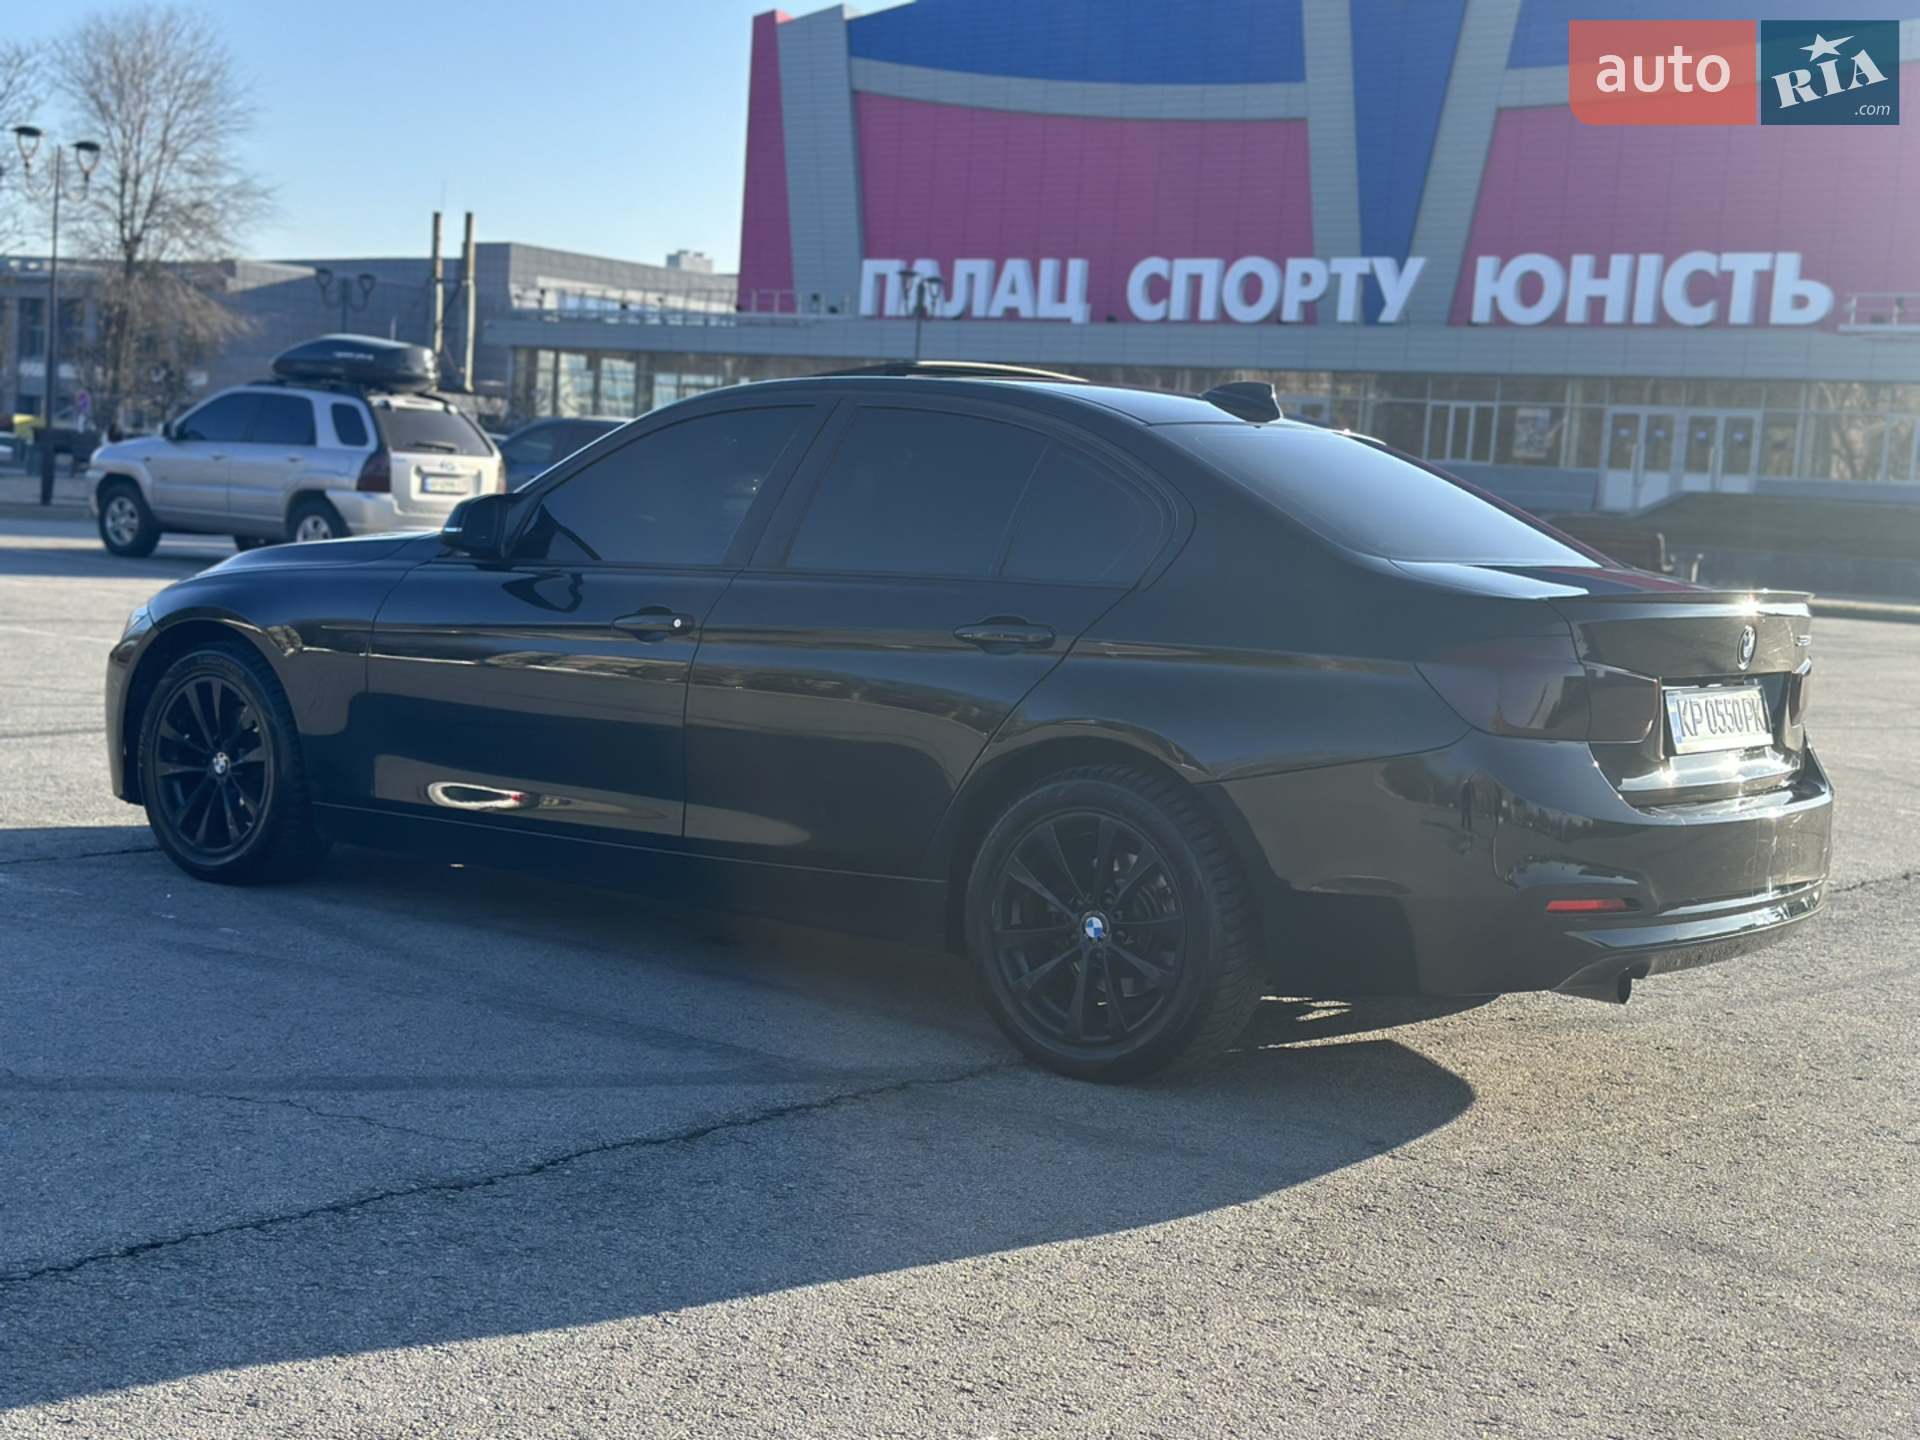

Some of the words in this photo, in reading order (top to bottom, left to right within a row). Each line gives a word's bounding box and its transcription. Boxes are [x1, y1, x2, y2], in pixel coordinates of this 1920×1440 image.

[859, 258, 1091, 324] ПАЛАЦ
[1126, 256, 1426, 323] СПОРТУ
[1471, 250, 1835, 327] ЮНІСТЬ
